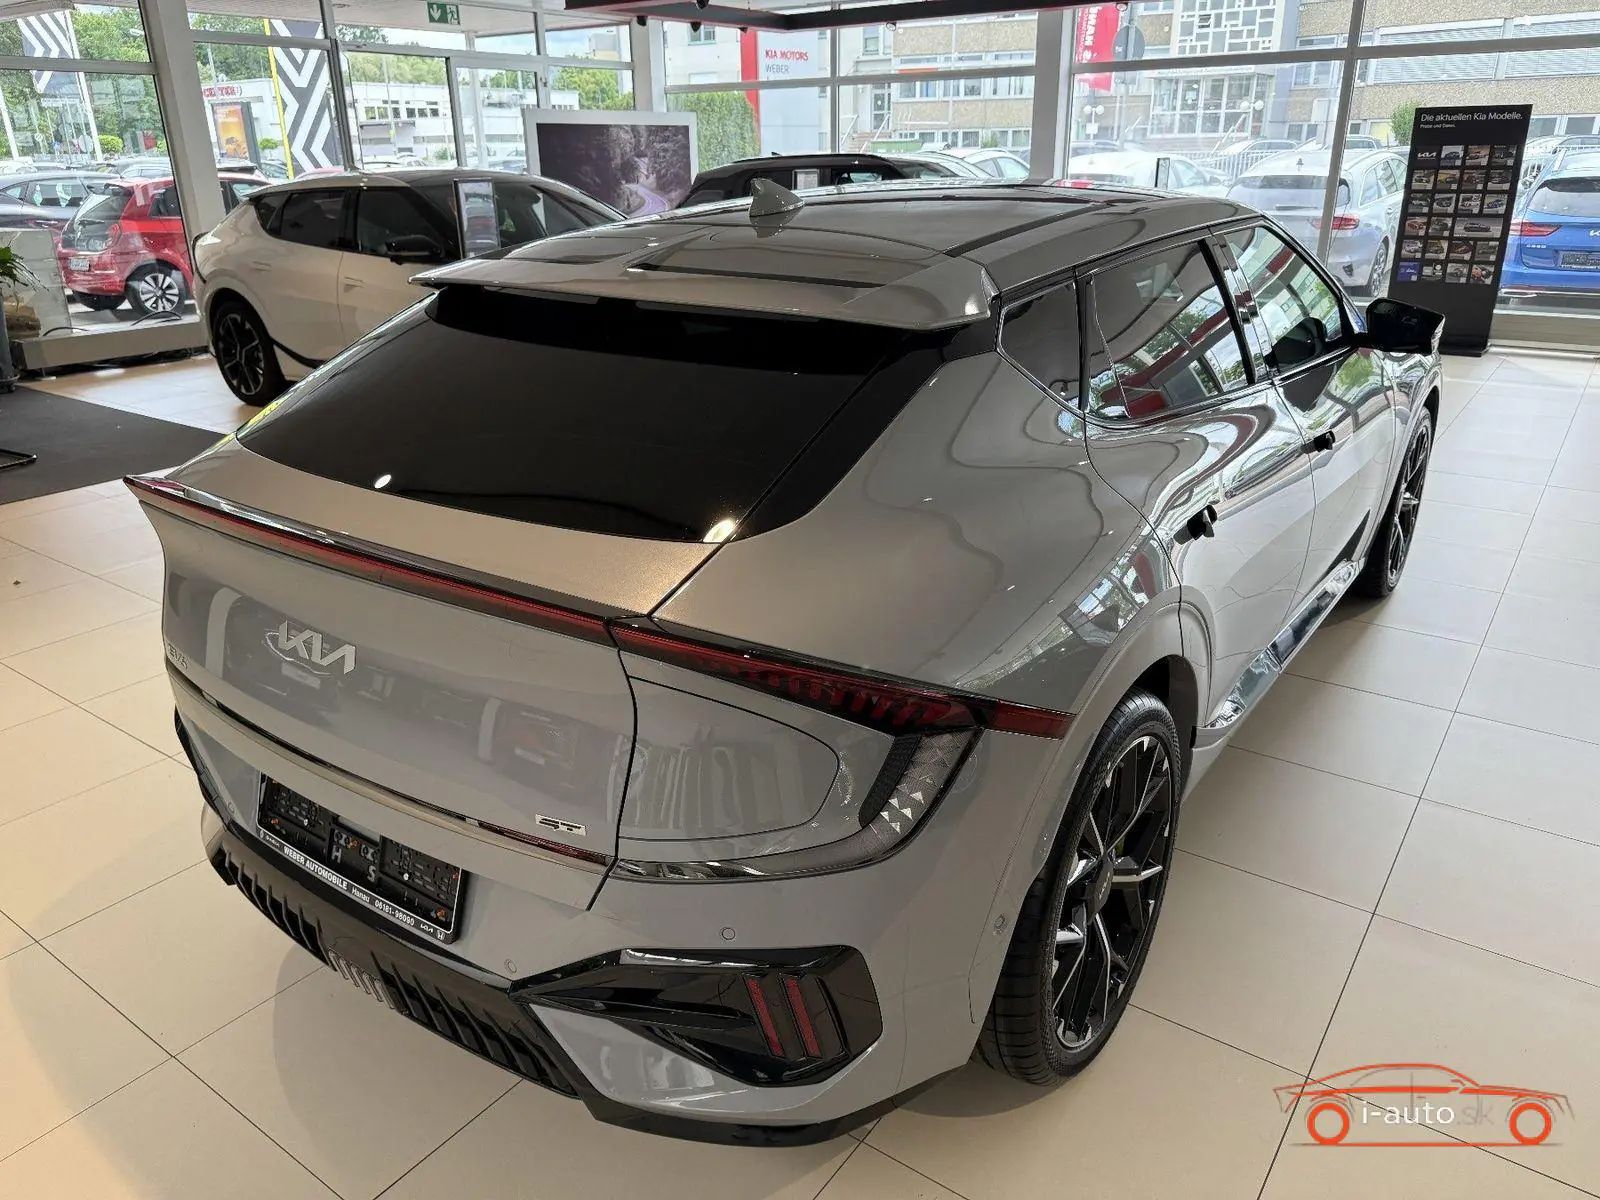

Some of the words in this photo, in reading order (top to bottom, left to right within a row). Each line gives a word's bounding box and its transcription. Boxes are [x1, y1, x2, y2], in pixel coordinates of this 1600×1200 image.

[765, 49, 777, 59] KIA
[779, 50, 809, 61] MOTORS
[765, 63, 789, 73] WEBER
[1420, 113, 1434, 122] Die
[1435, 112, 1472, 121] aktuellen
[1473, 112, 1487, 120] Kia
[1488, 111, 1523, 120] Modelle.
[278, 619, 356, 675] KIA
[283, 845, 305, 865] WEBER
[305, 859, 348, 890] AUTOMOBILE
[351, 886, 370, 903] Hanau
[374, 899, 415, 926] 06181-98090
